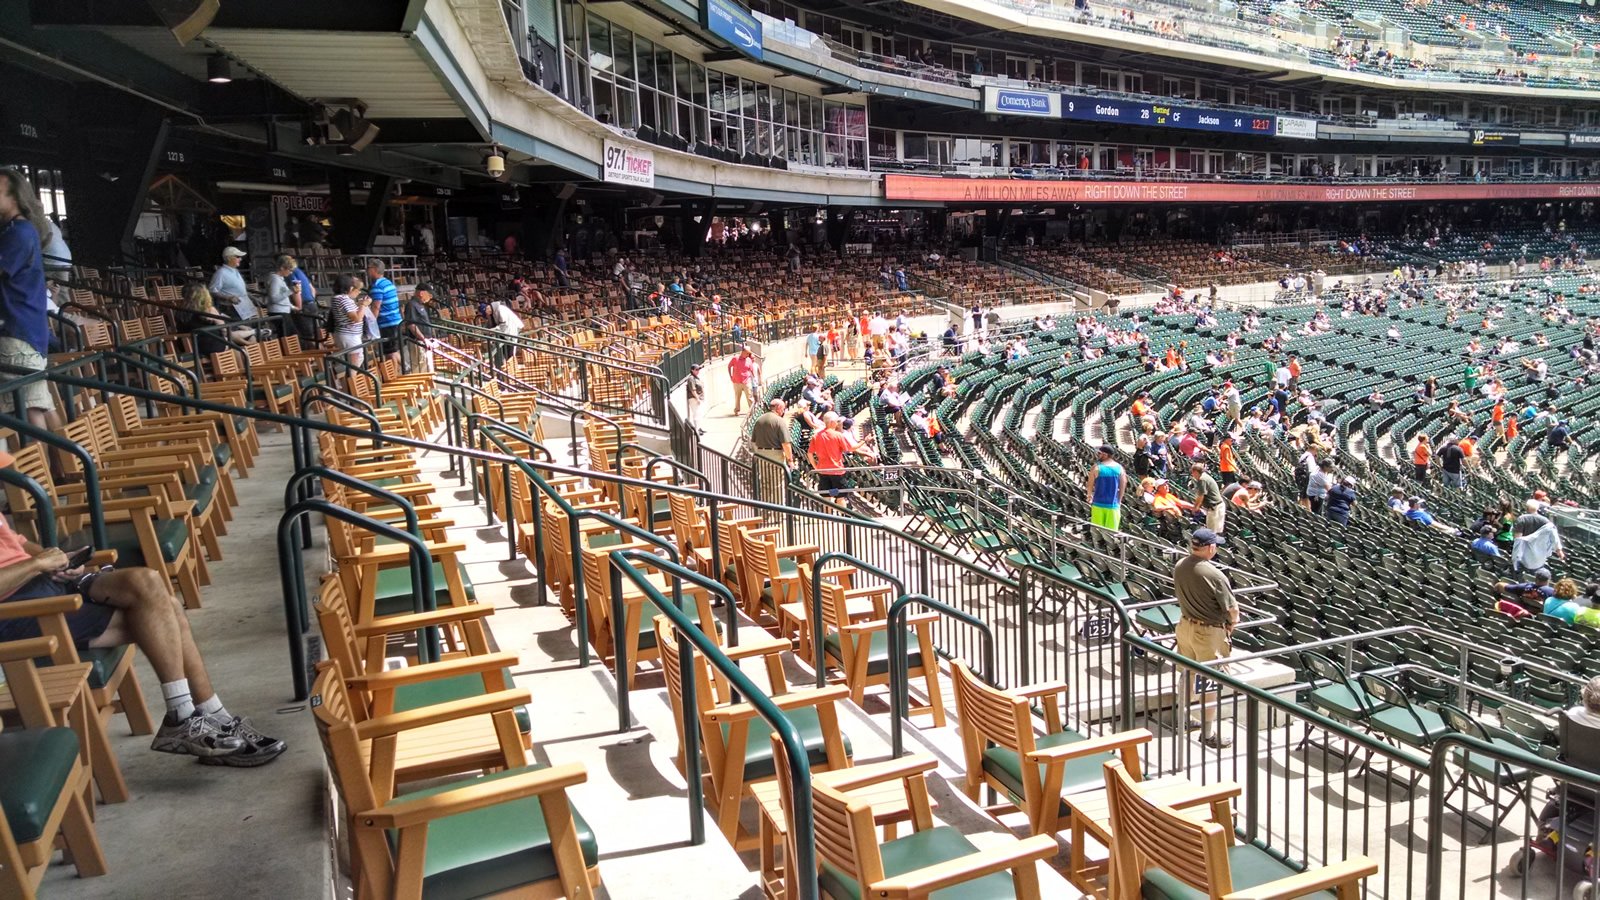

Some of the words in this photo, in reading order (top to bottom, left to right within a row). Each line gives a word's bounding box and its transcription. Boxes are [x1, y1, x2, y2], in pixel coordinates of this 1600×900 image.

[1031, 98, 1047, 108] Bank
[1068, 101, 1075, 112] 9
[1095, 104, 1120, 116] Gordon
[1140, 109, 1150, 119] 2B
[1157, 116, 1165, 124] 1st
[1172, 112, 1181, 122] CF
[1198, 115, 1220, 126] Jackson
[1234, 119, 1242, 127] 14
[1252, 119, 1270, 130] 12:17
[1474, 130, 1484, 141] yp
[606, 146, 626, 170] 97.1
[626, 156, 652, 176] TICKET
[964, 185, 972, 199] A
[974, 185, 1018, 200] MILLION
[1020, 186, 1049, 200] MILES
[1050, 187, 1080, 200] AWAY
[1085, 185, 1112, 198] RIGHT
[1113, 185, 1140, 198] DOWN
[1141, 186, 1158, 199] THE
[1159, 186, 1188, 199] STREET
[1345, 188, 1370, 199] DOWN
[1372, 188, 1387, 199] THE
[1388, 187, 1416, 198] STREET
[291, 196, 323, 211] LEAGUE
